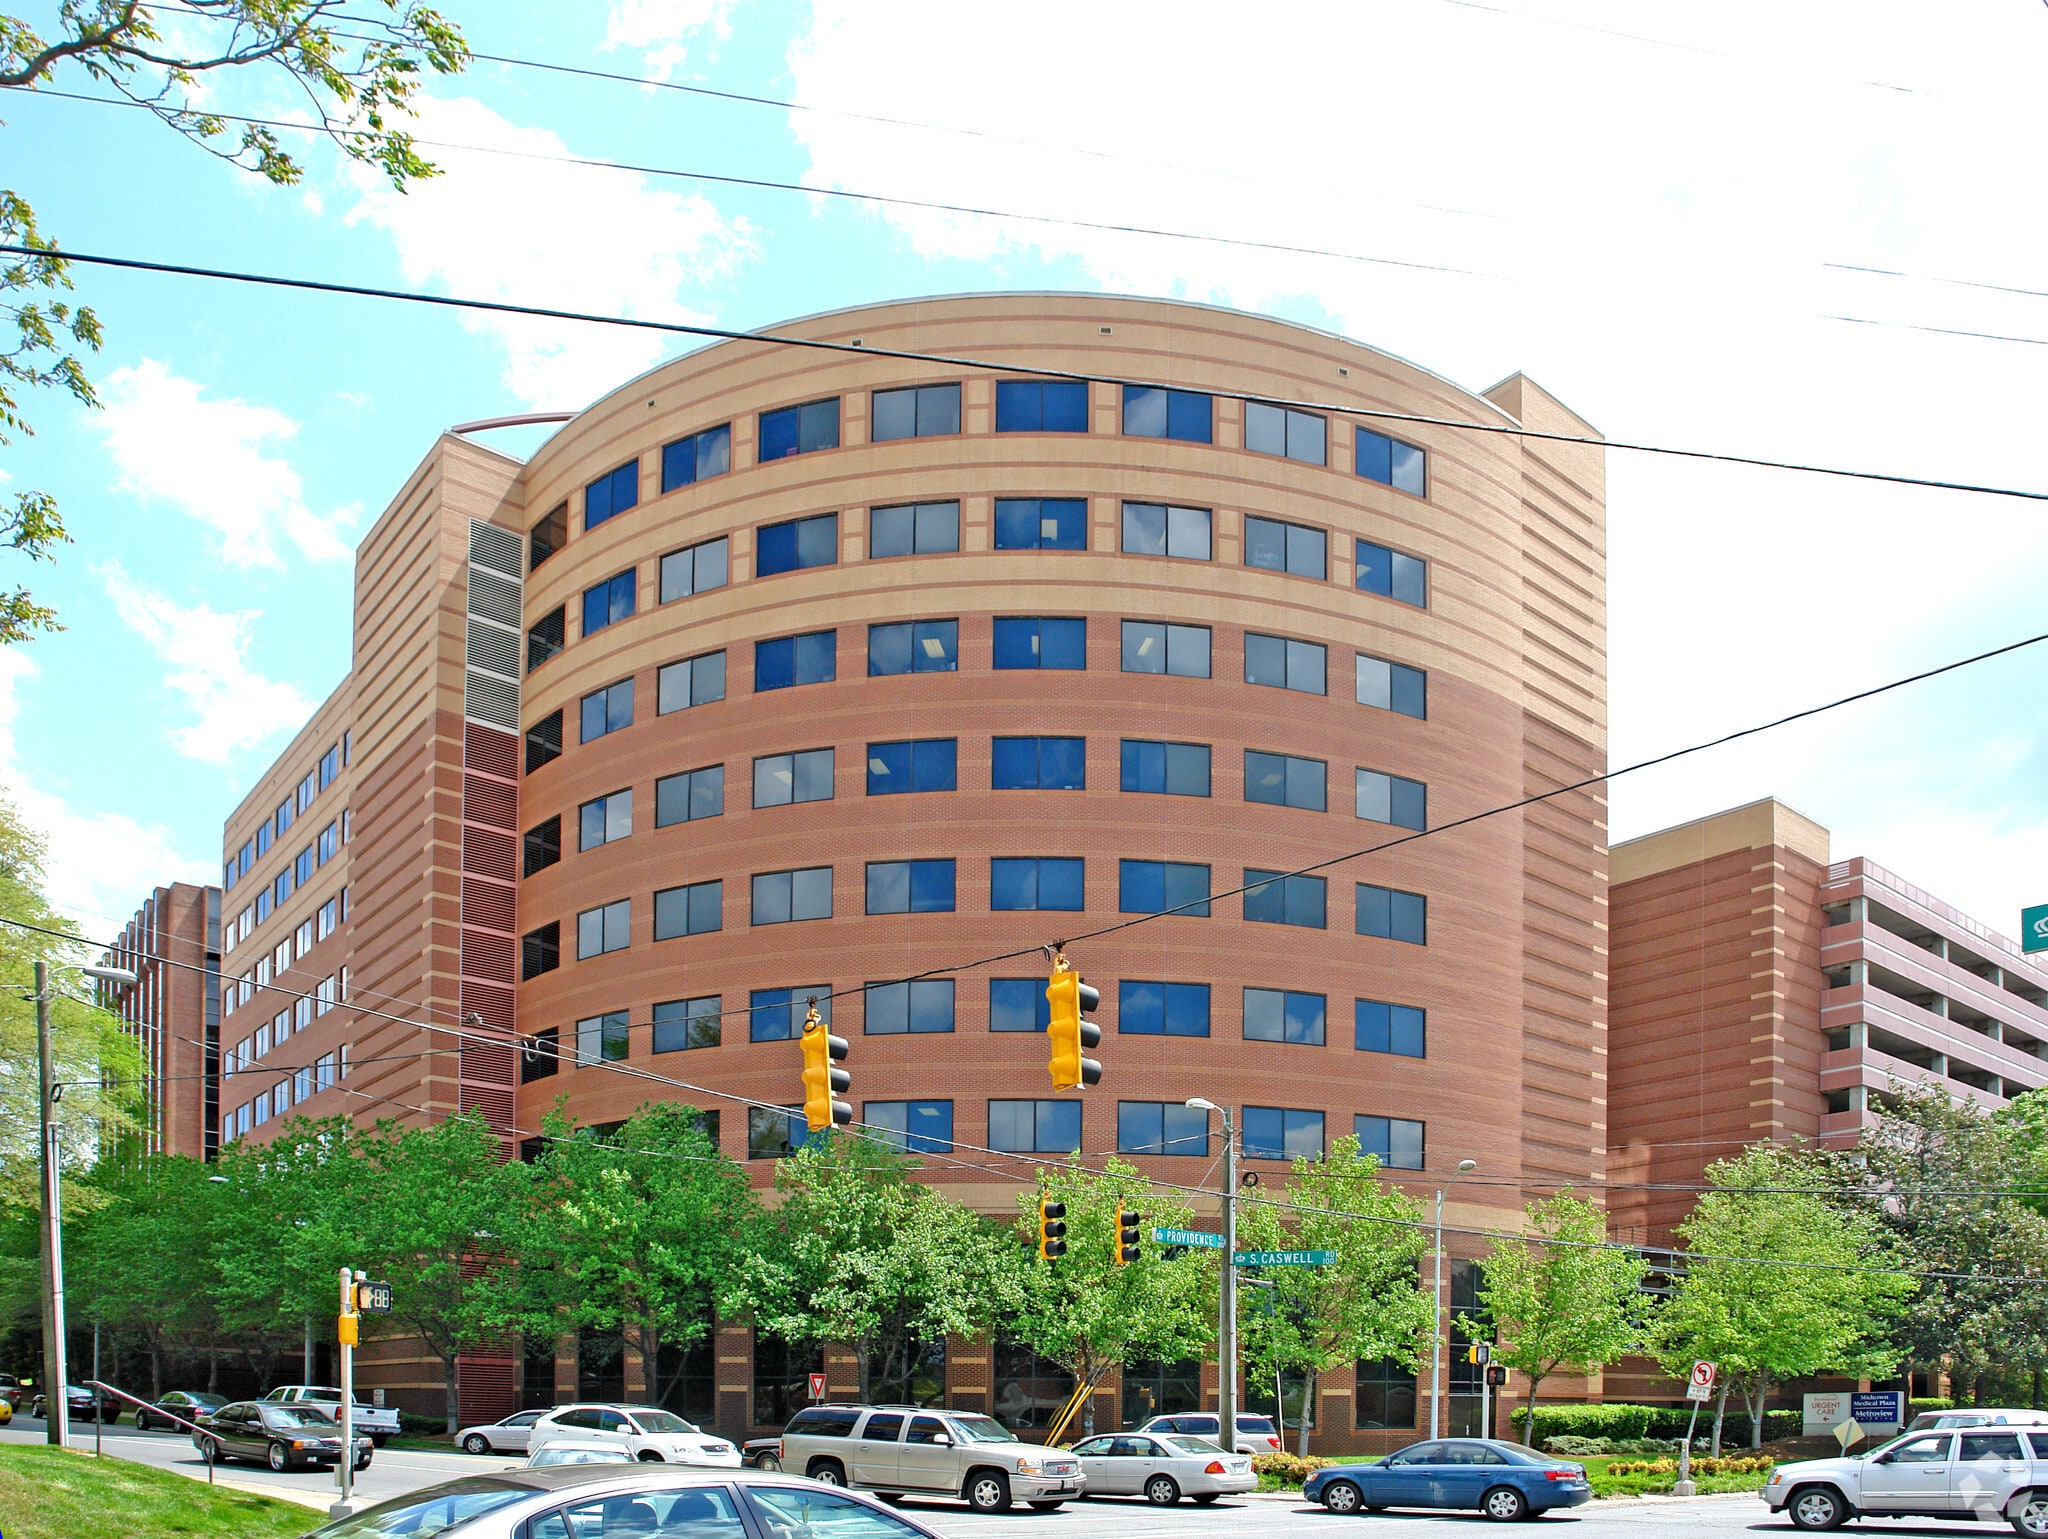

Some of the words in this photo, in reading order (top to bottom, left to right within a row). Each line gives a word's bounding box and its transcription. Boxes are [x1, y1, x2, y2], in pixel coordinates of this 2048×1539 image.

[1166, 1231, 1214, 1246] PROVIDENCE
[1250, 1253, 1259, 1264] S.
[1261, 1253, 1314, 1264] CASWELL
[1855, 1409, 1894, 1417] Metroview
